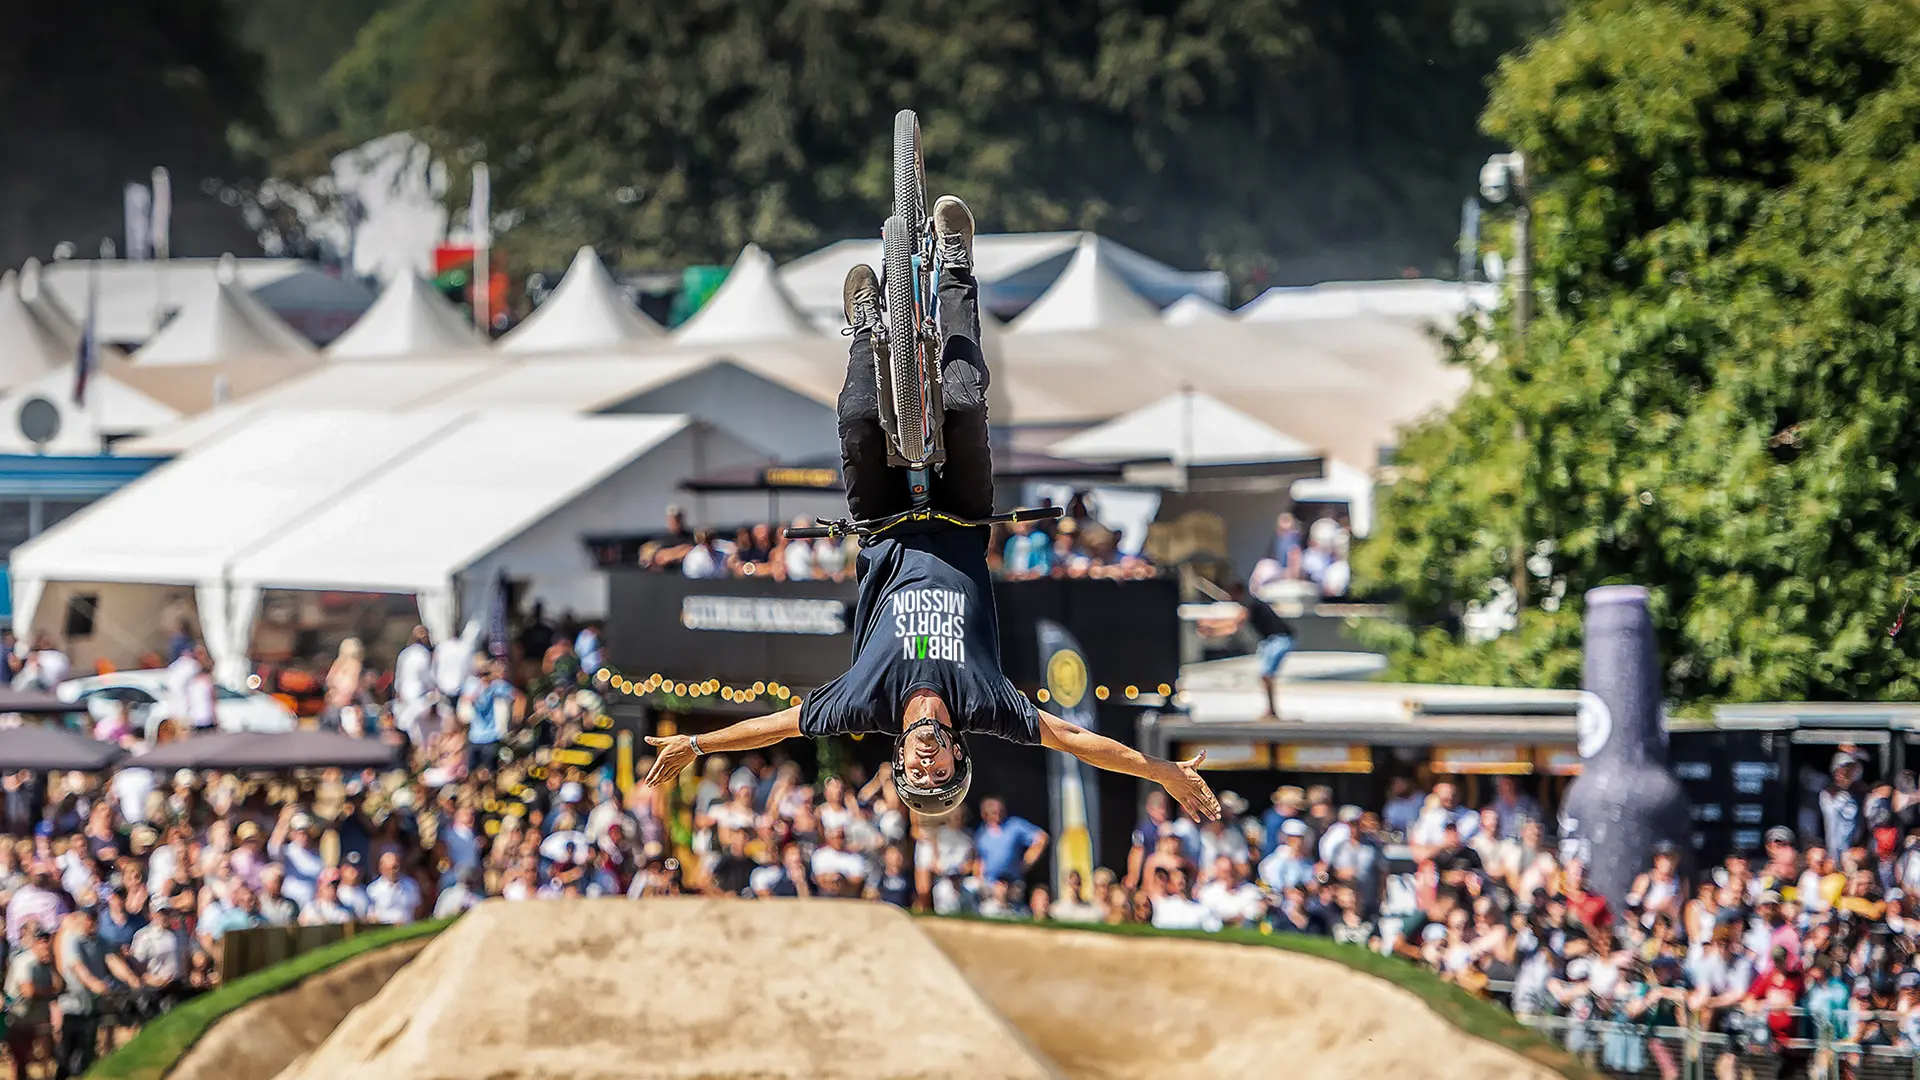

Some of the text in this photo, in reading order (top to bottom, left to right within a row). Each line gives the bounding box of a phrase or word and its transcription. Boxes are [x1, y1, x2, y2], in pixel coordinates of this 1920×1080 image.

[892, 589, 965, 616] MISSION
[895, 612, 964, 639] SPORTS
[903, 636, 965, 663] URBAN
